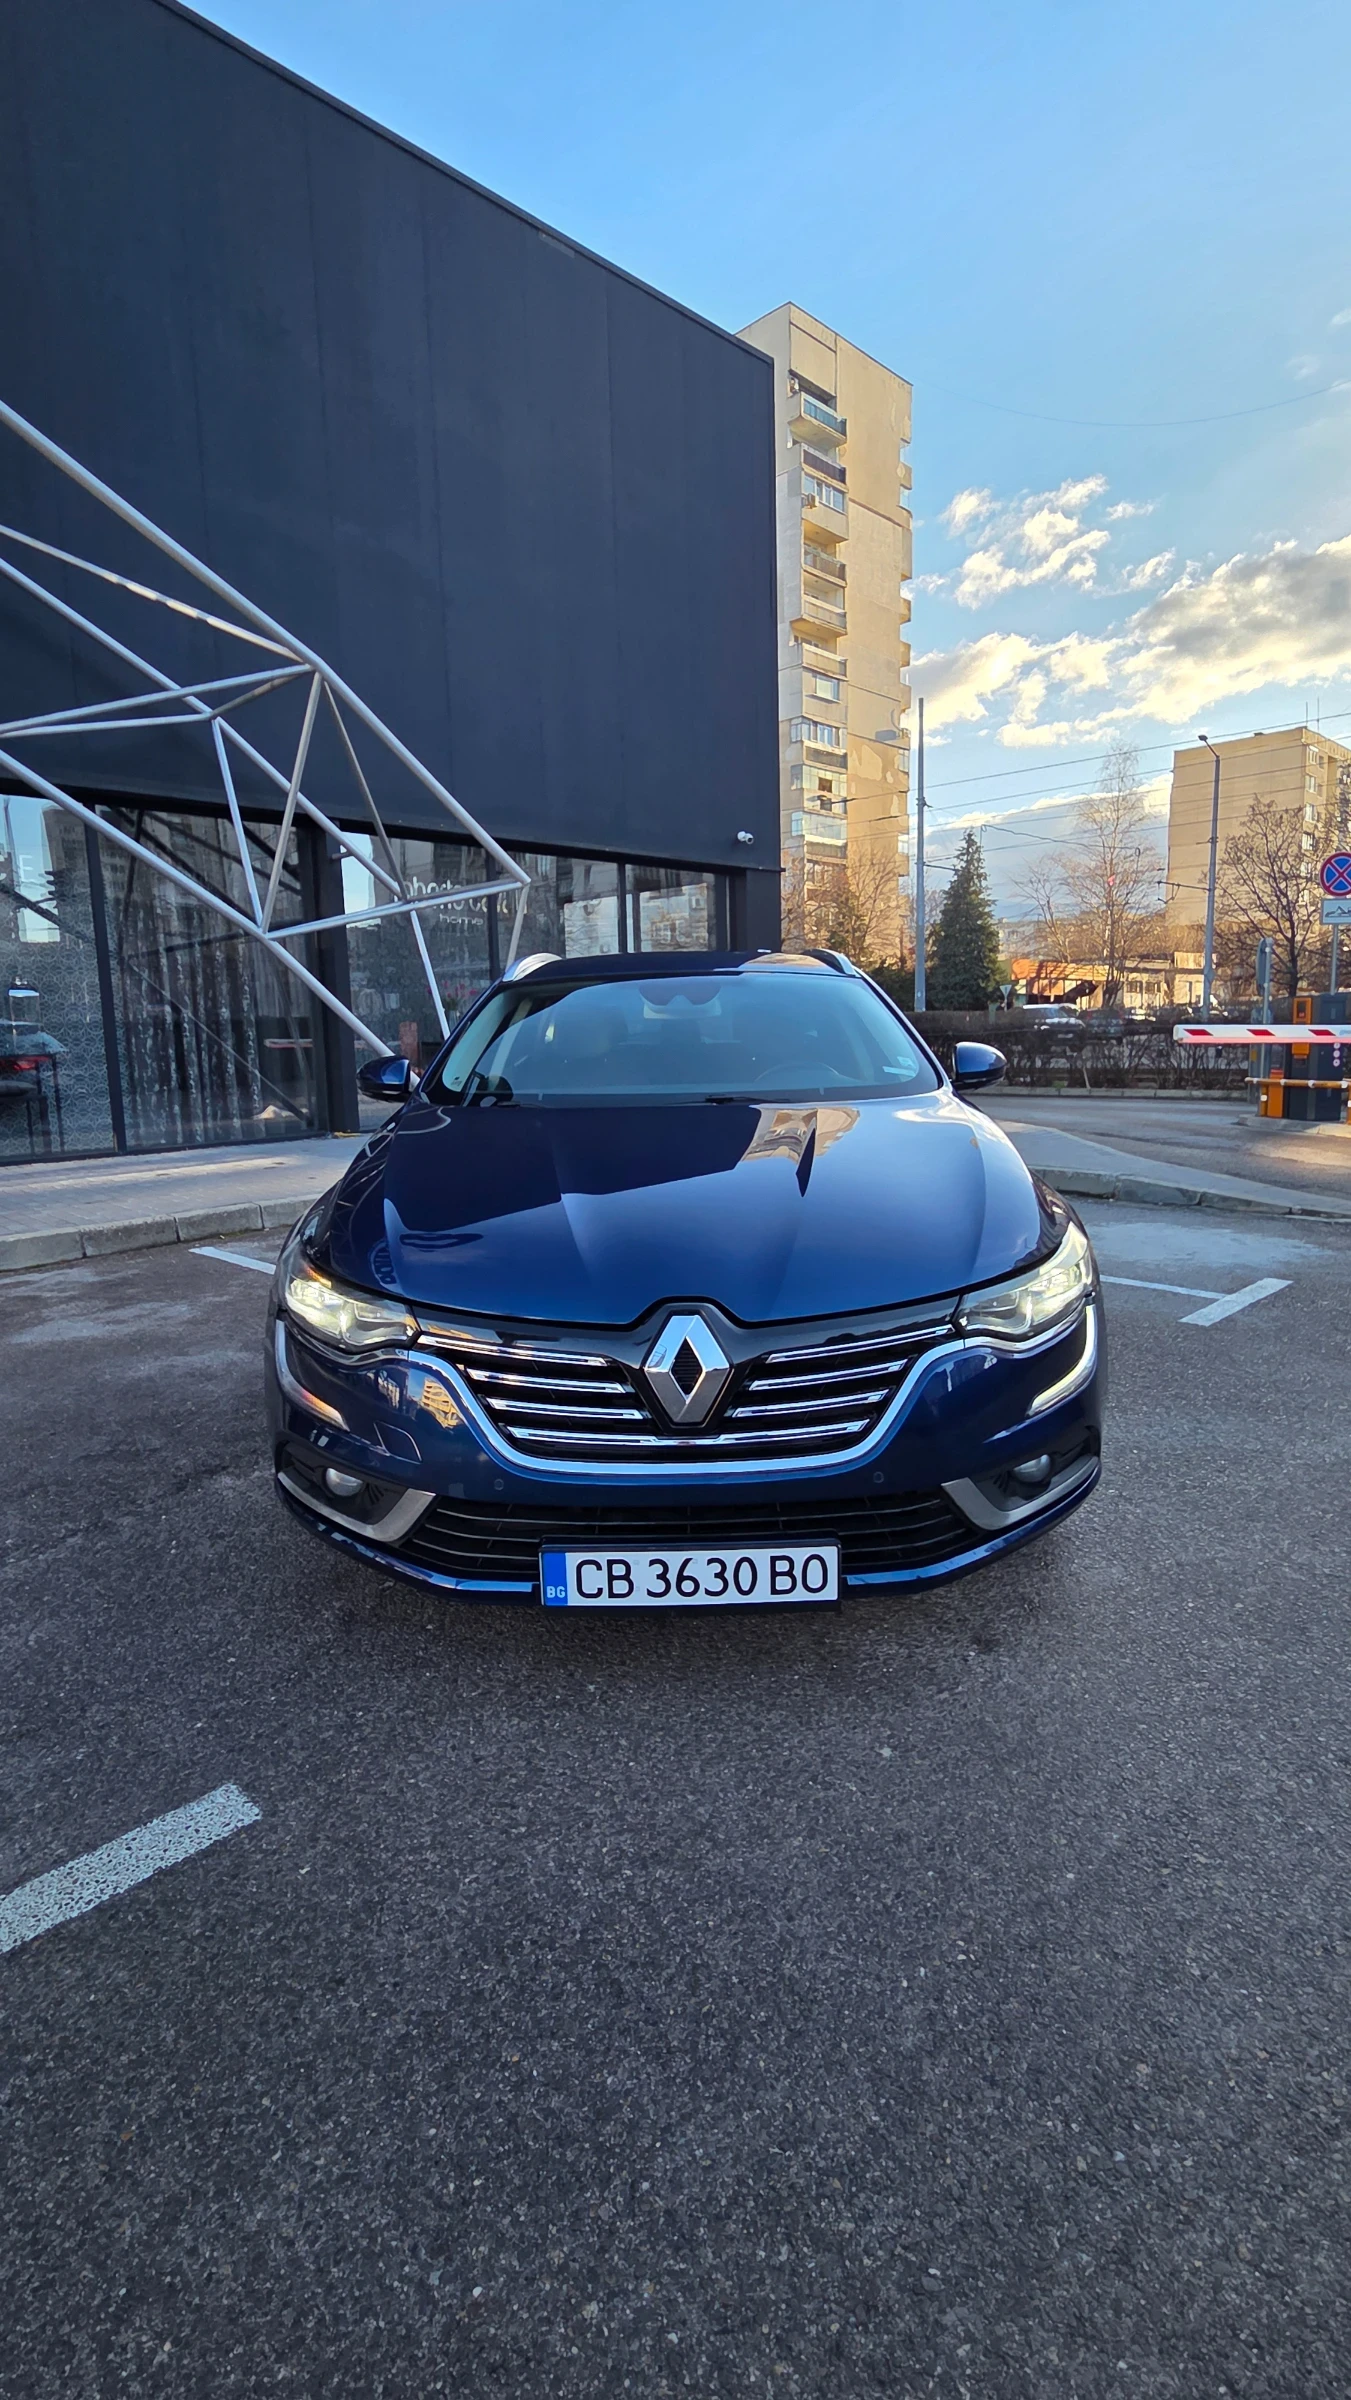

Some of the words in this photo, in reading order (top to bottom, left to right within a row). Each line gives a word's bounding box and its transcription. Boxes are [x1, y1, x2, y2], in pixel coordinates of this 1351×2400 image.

[439, 913, 484, 926] home
[575, 1558, 635, 1599] CB
[646, 1556, 759, 1598] 3630
[769, 1553, 829, 1596] BO
[546, 1585, 566, 1599] BG
